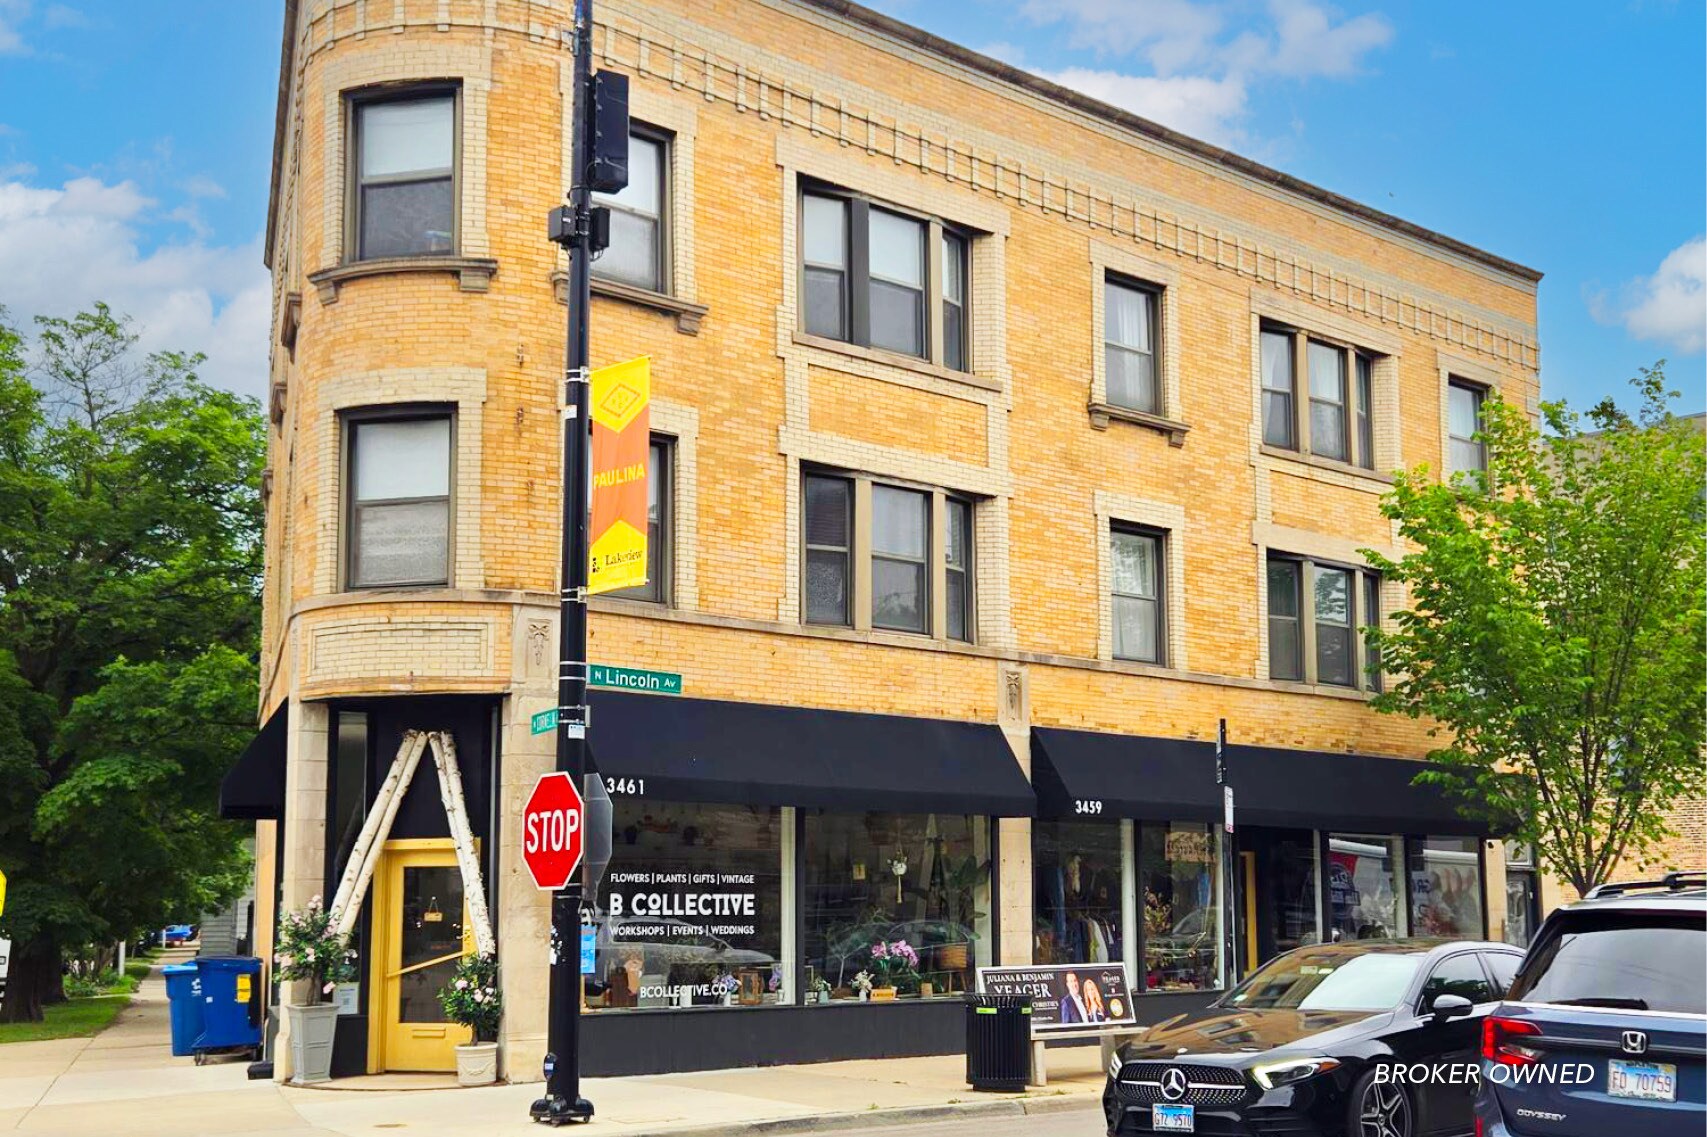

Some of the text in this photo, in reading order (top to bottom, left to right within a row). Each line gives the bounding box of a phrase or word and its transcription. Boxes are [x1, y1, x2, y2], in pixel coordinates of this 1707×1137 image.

[594, 463, 646, 490] PAULINA
[605, 549, 643, 567] Lakeview
[594, 669, 676, 689] N Lincoln Av
[607, 777, 644, 795] 3461
[1075, 800, 1103, 814] 3459
[526, 808, 579, 853] STOP
[610, 873, 755, 884] FLOWERS PLANTS GIFTS VINTAGE
[609, 893, 756, 916] B COLLECTIVE
[611, 925, 755, 936] WORKSHOPS EVENTS WEDDINGS
[987, 972, 1055, 984] JULIANA & BENJAMIN
[639, 984, 728, 999] BCOLLECTIVE.CO
[994, 983, 1052, 998] YEAGER
[1635, 1072, 1671, 1093] 70759
[1516, 1108, 1567, 1122] ODYSSEY
